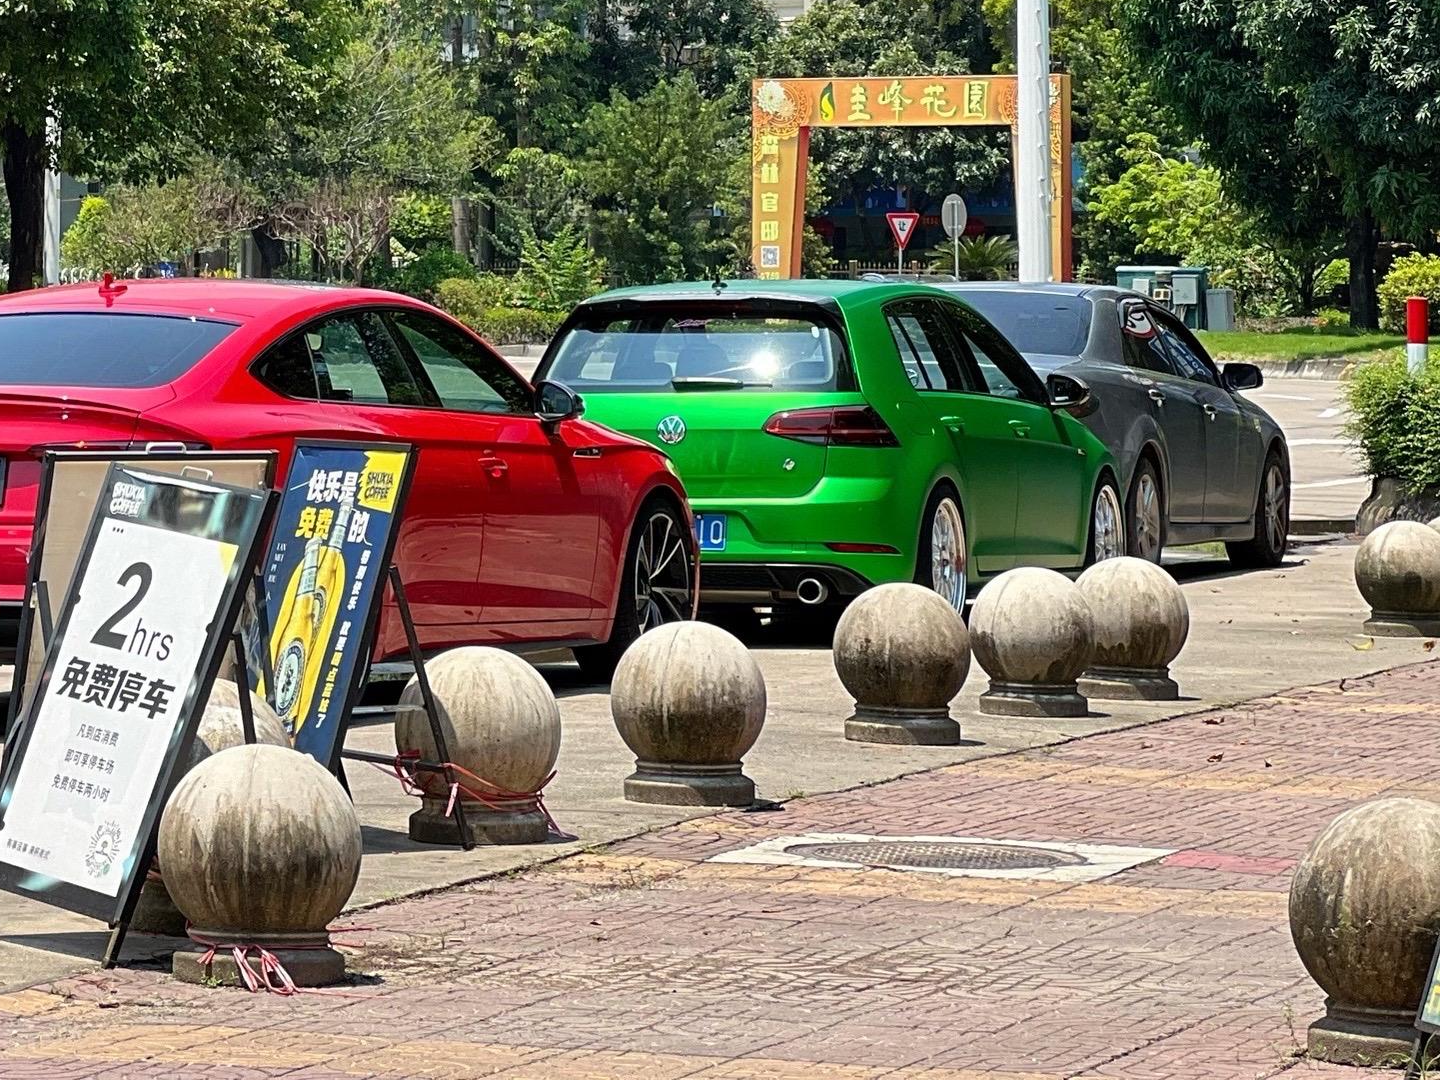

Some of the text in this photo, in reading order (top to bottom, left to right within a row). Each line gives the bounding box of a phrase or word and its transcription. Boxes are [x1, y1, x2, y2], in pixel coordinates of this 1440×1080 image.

[306, 469, 359, 503] 快乐是
[364, 486, 391, 502] COFFEE
[110, 498, 142, 517] COFFEE
[90, 561, 174, 661] 2 hrs
[56, 656, 176, 720] 免费停车
[76, 723, 120, 747] 凡到店消费
[64, 748, 115, 775] 即可享停车场
[51, 773, 111, 802] 免费停车两小时
